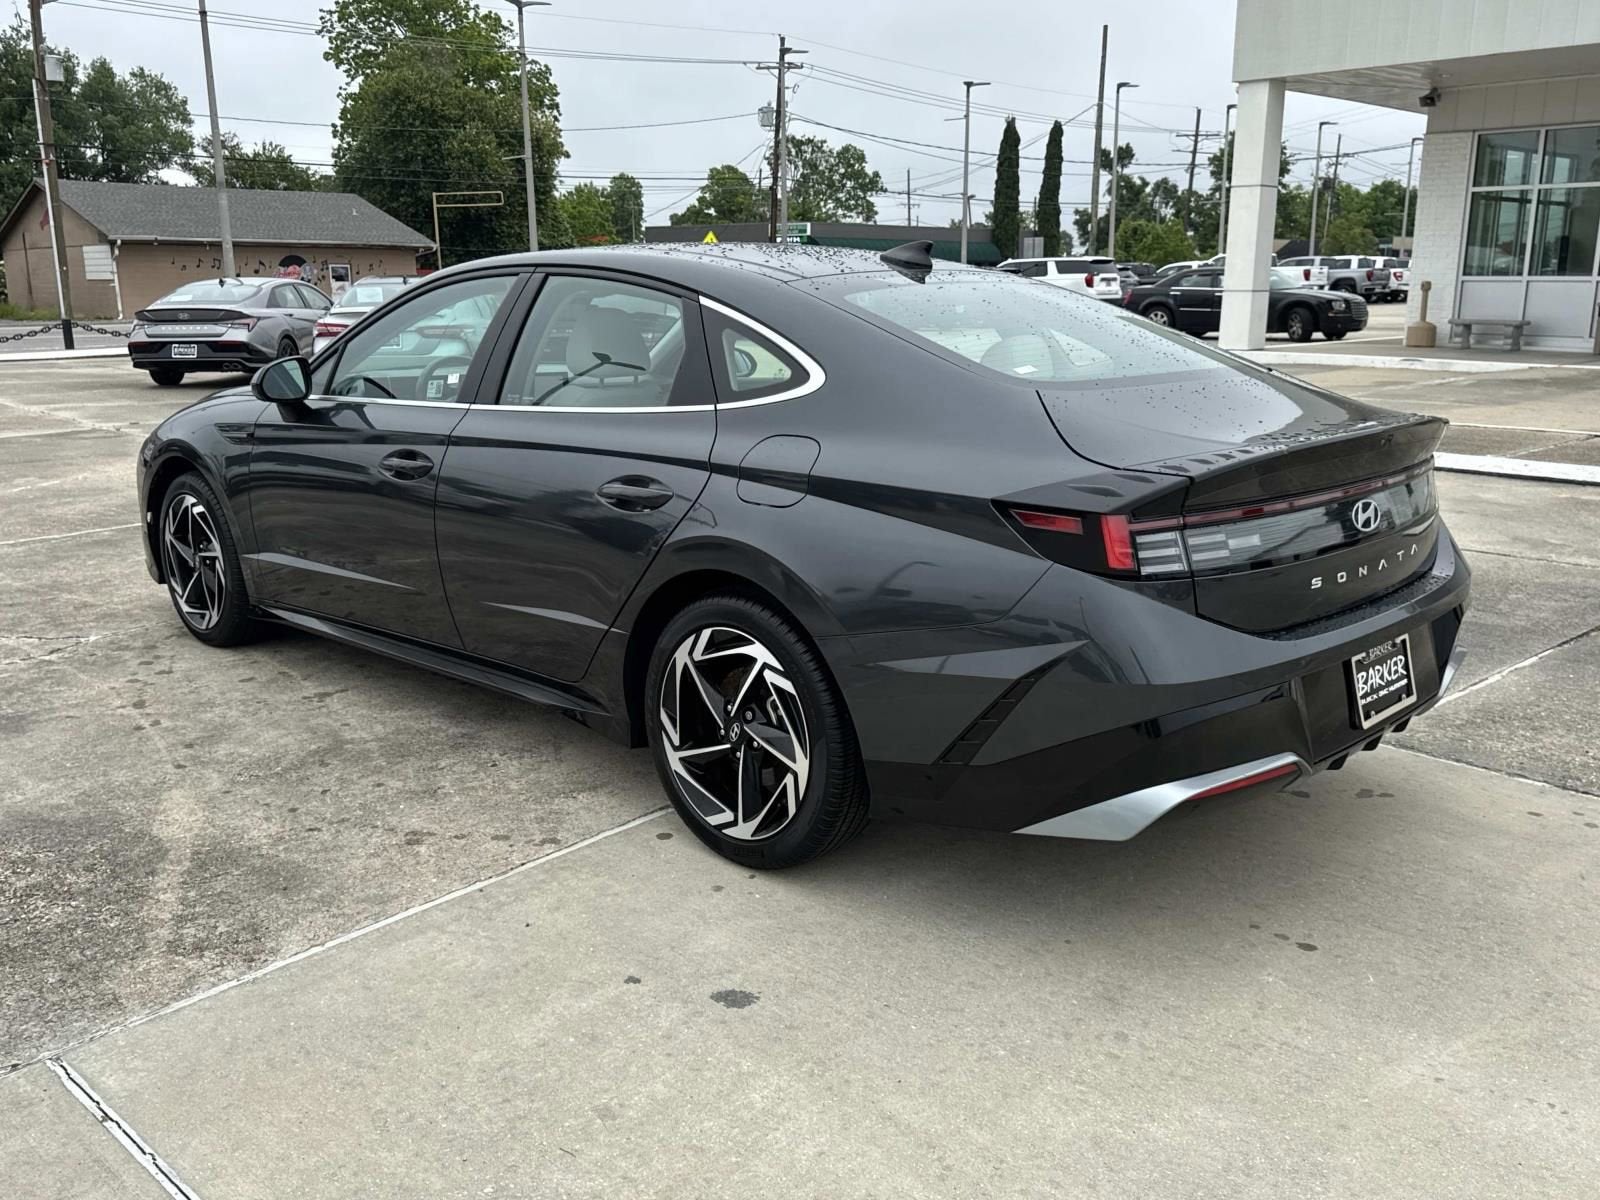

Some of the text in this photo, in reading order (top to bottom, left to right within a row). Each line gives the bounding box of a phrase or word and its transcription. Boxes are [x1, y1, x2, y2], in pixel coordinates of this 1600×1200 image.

[1311, 544, 1418, 589] SONATA
[1368, 640, 1393, 658] BARKER
[1356, 654, 1407, 696] BARKER
